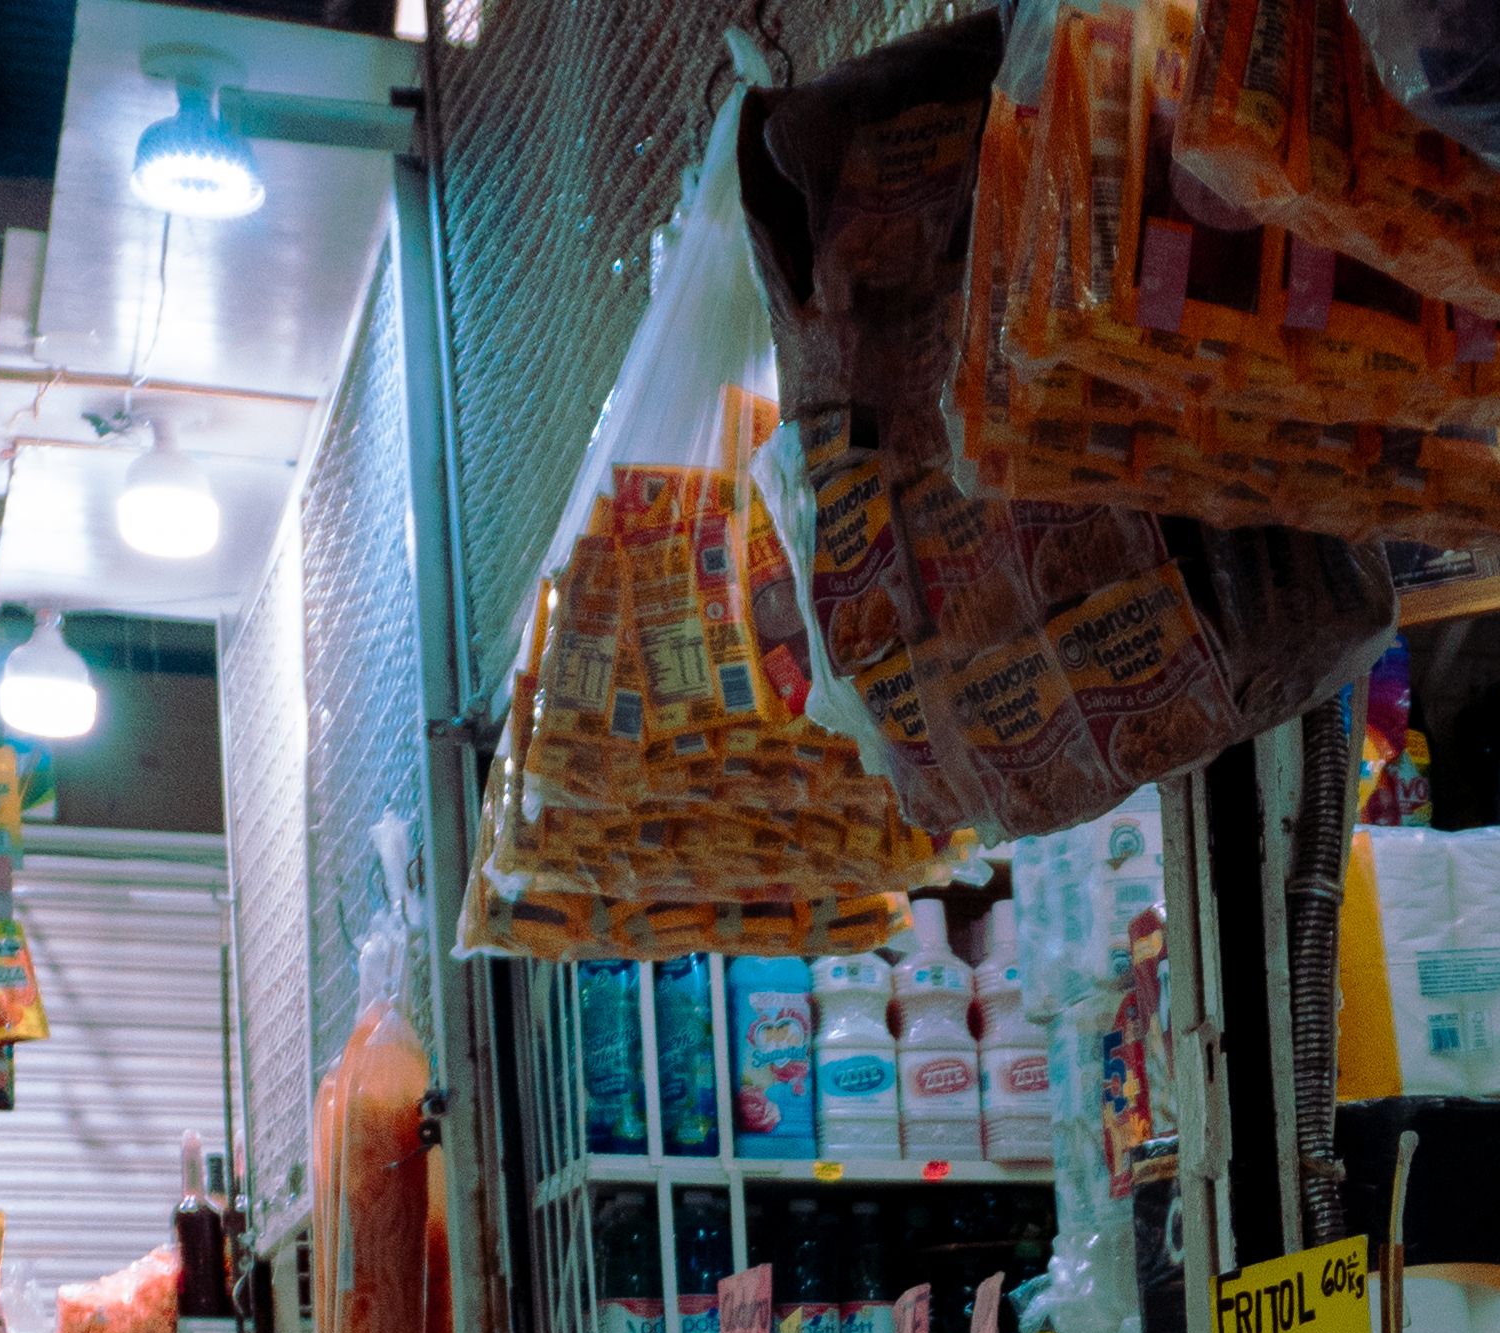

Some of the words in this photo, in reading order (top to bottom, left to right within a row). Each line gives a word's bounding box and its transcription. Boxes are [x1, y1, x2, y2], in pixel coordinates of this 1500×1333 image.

[1076, 585, 1176, 643] Maruchan
[1093, 625, 1164, 667] Instant
[1111, 647, 1164, 682] Lunch
[964, 651, 1049, 707] Maruchan
[981, 687, 1041, 725] Instant
[994, 708, 1043, 740] Lunch
[921, 1067, 966, 1090] ZOTE
